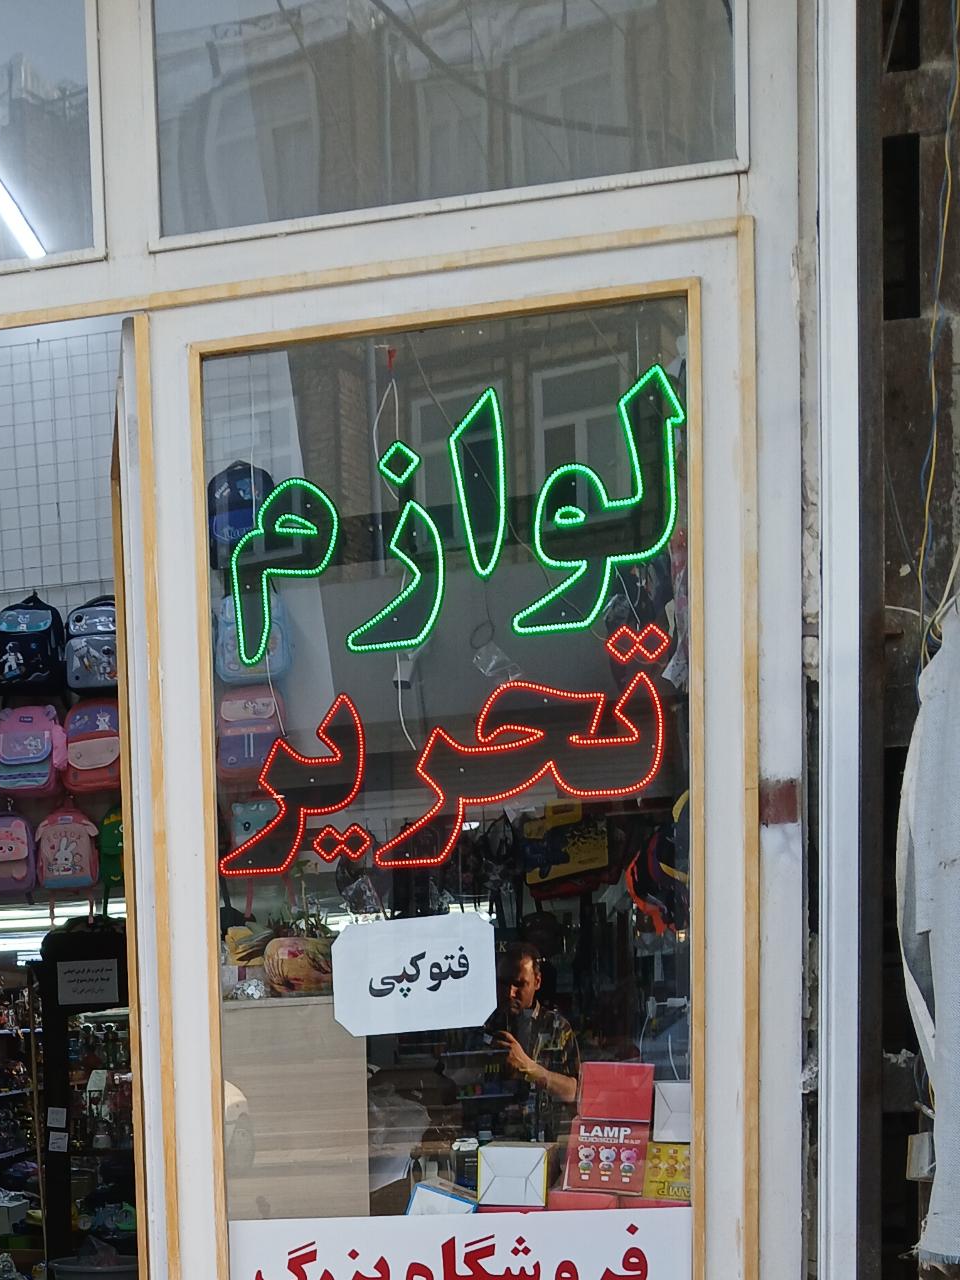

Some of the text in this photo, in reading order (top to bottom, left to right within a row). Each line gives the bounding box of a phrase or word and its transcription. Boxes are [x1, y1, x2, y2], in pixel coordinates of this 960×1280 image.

[230, 363, 688, 667] لوازم
[218, 622, 671, 876] تحریر
[367, 944, 471, 1000] فتوکپی
[580, 1125, 631, 1144] LAMP
